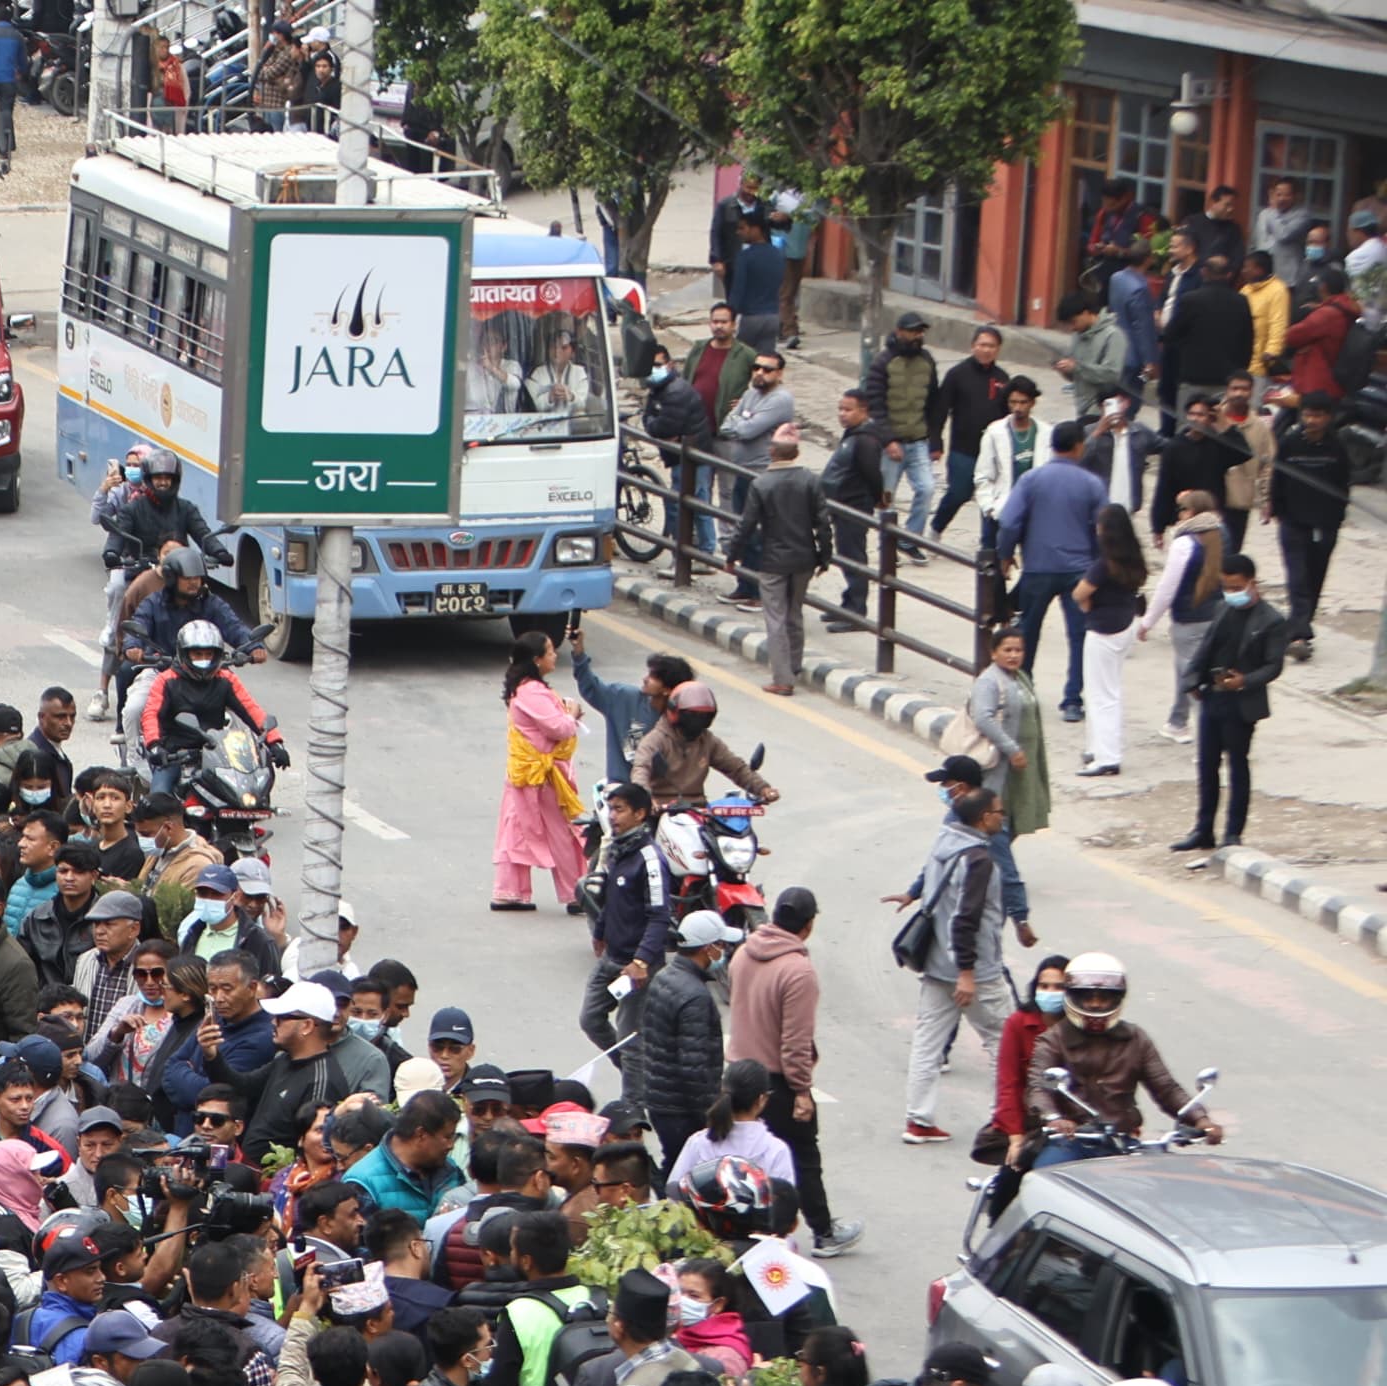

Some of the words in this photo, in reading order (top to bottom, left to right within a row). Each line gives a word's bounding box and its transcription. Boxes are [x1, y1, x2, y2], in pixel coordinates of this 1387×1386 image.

[288, 345, 415, 394] JARA
[312, 461, 381, 493] जरा
[548, 491, 593, 503] EXCELO
